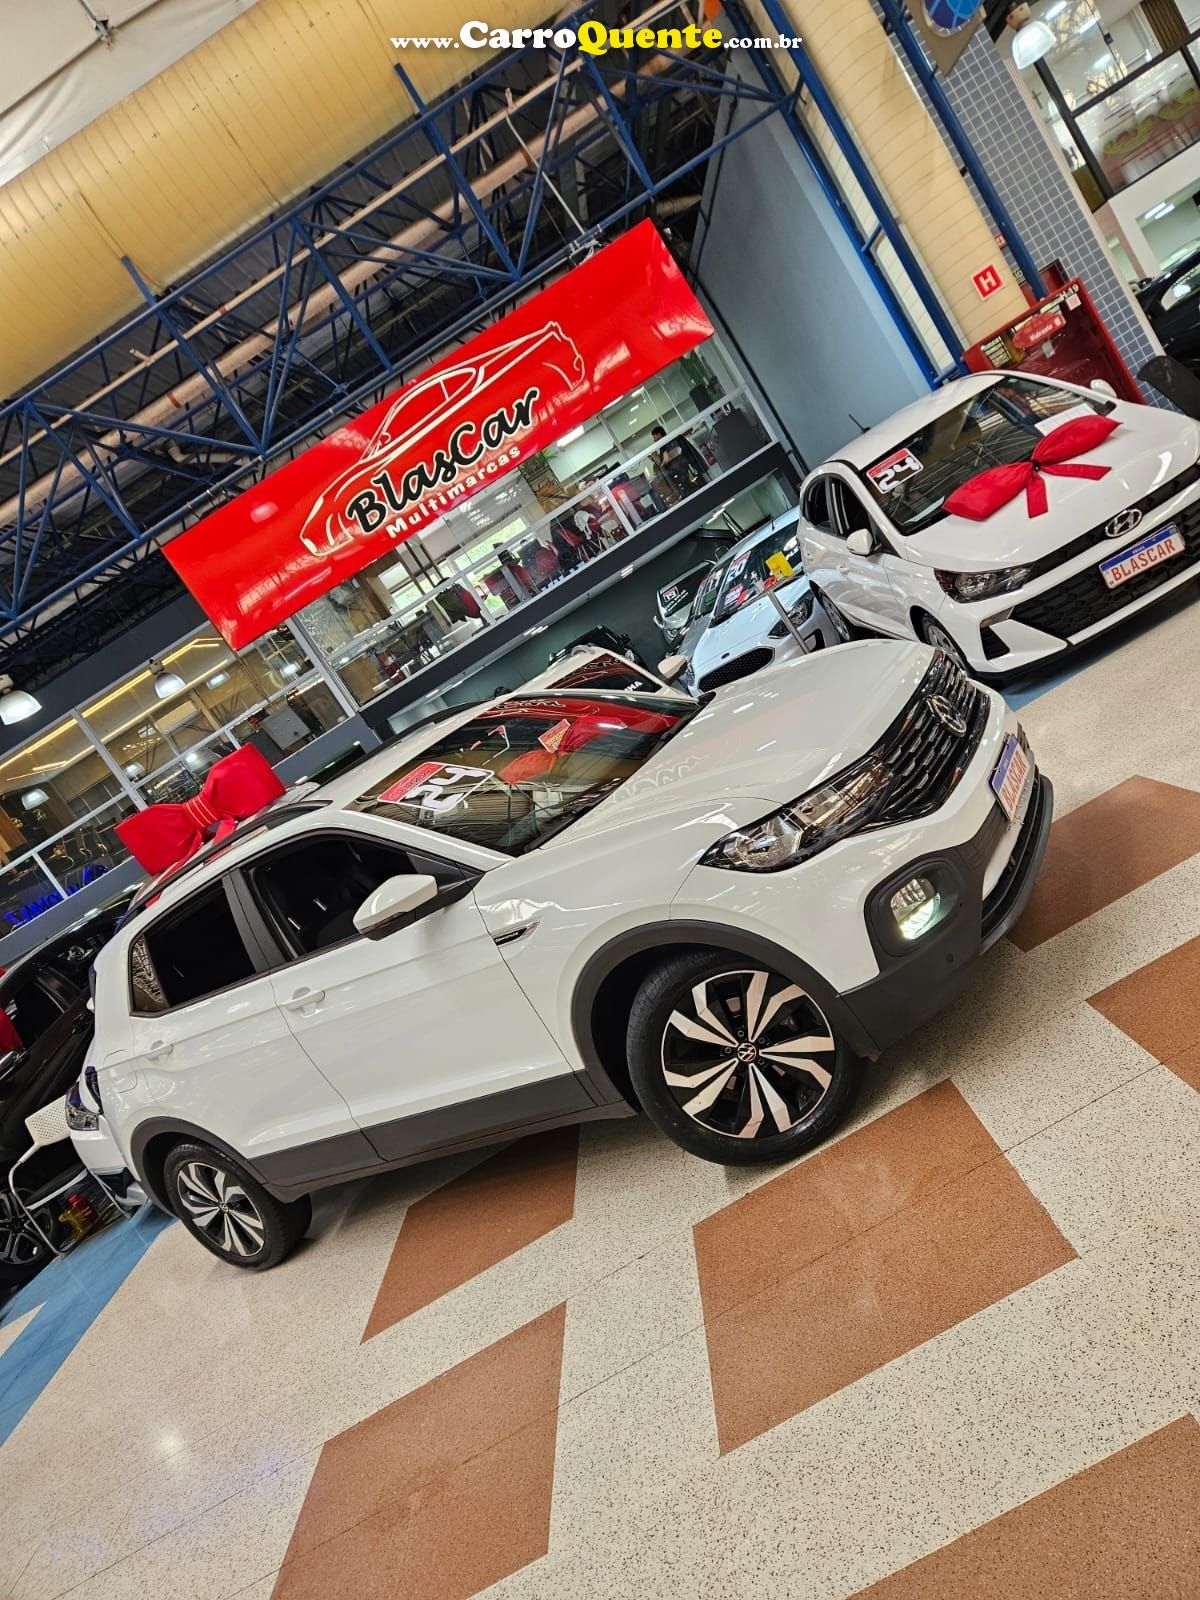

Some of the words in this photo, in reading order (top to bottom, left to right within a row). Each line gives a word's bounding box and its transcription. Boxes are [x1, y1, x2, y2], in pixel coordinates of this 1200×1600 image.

[346, 387, 540, 534] BlasCar
[875, 456, 920, 490] 24
[386, 445, 521, 539] Multimarcas
[1110, 539, 1176, 582] BLASCAR
[404, 767, 489, 810] 24
